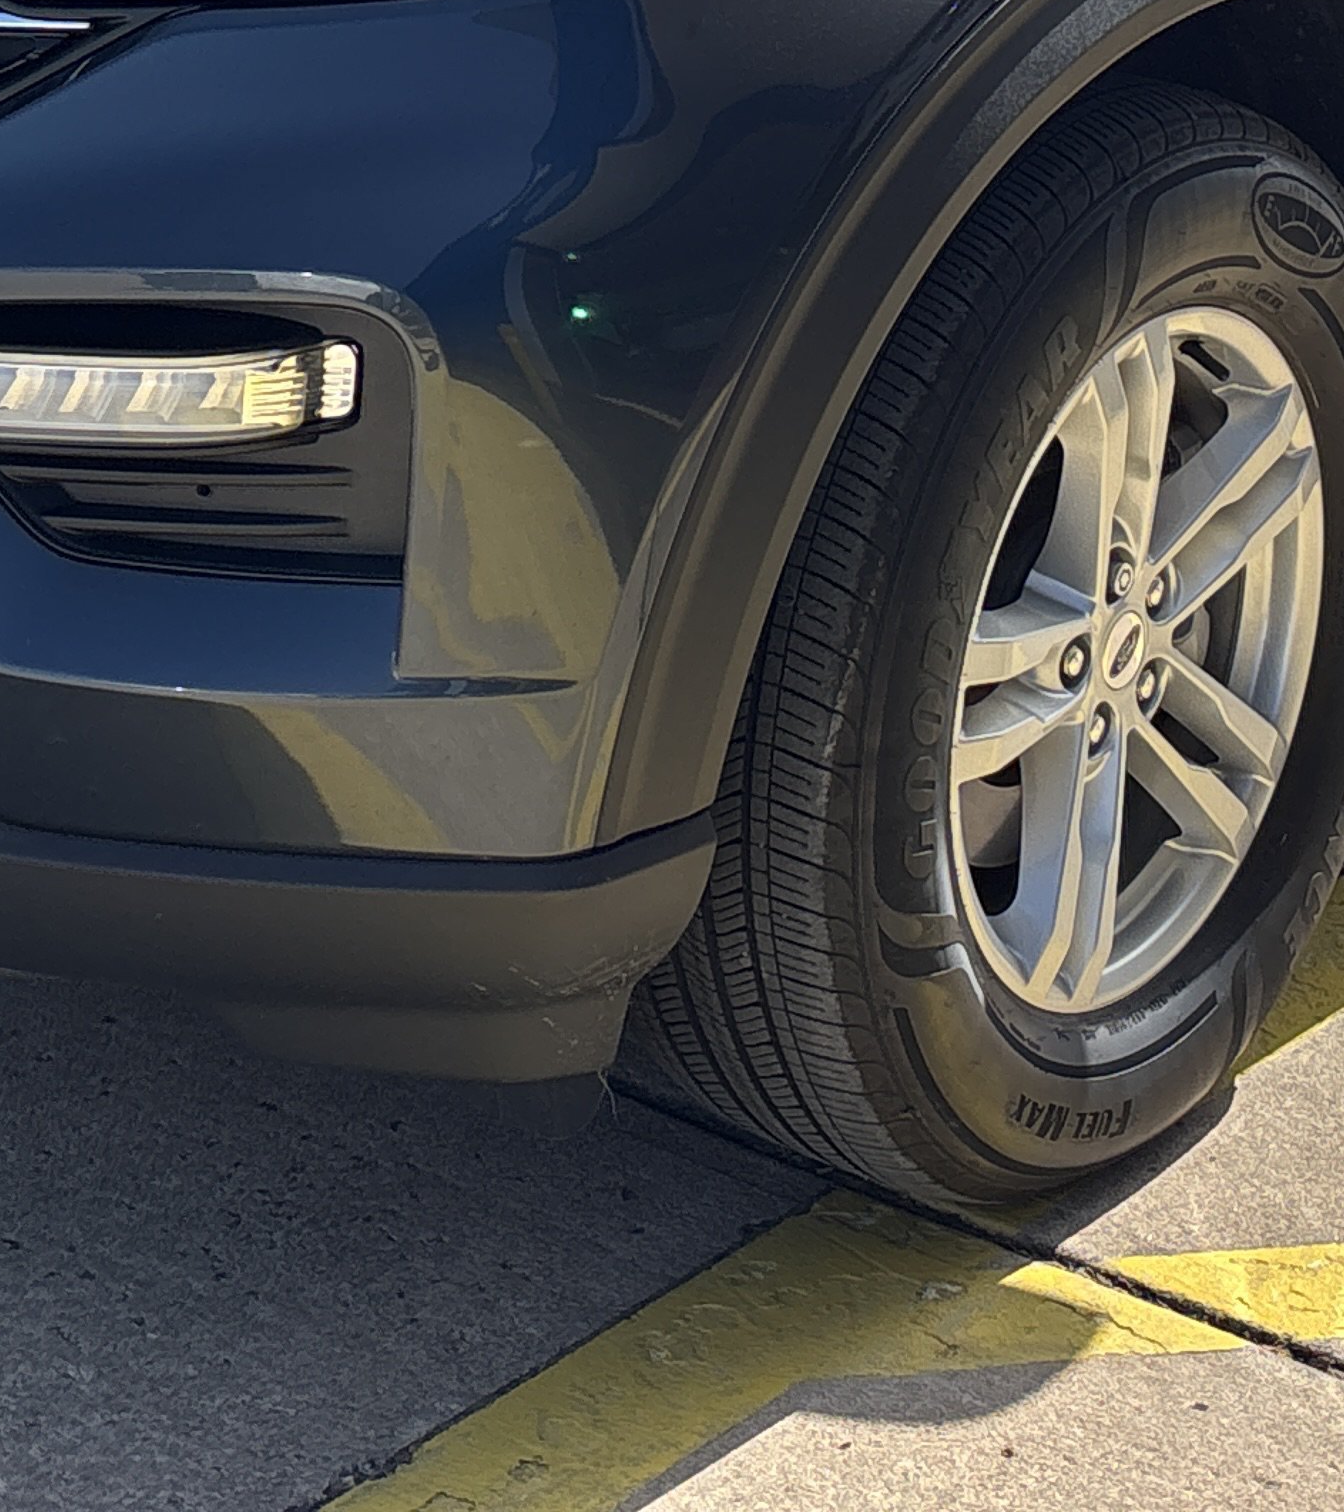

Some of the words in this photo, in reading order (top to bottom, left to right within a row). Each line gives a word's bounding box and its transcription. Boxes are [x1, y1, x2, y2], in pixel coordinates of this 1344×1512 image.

[904, 315, 1084, 880] GOODYEAR
[1010, 1093, 1071, 1142] MAX
[1071, 1098, 1134, 1140] FUEL
